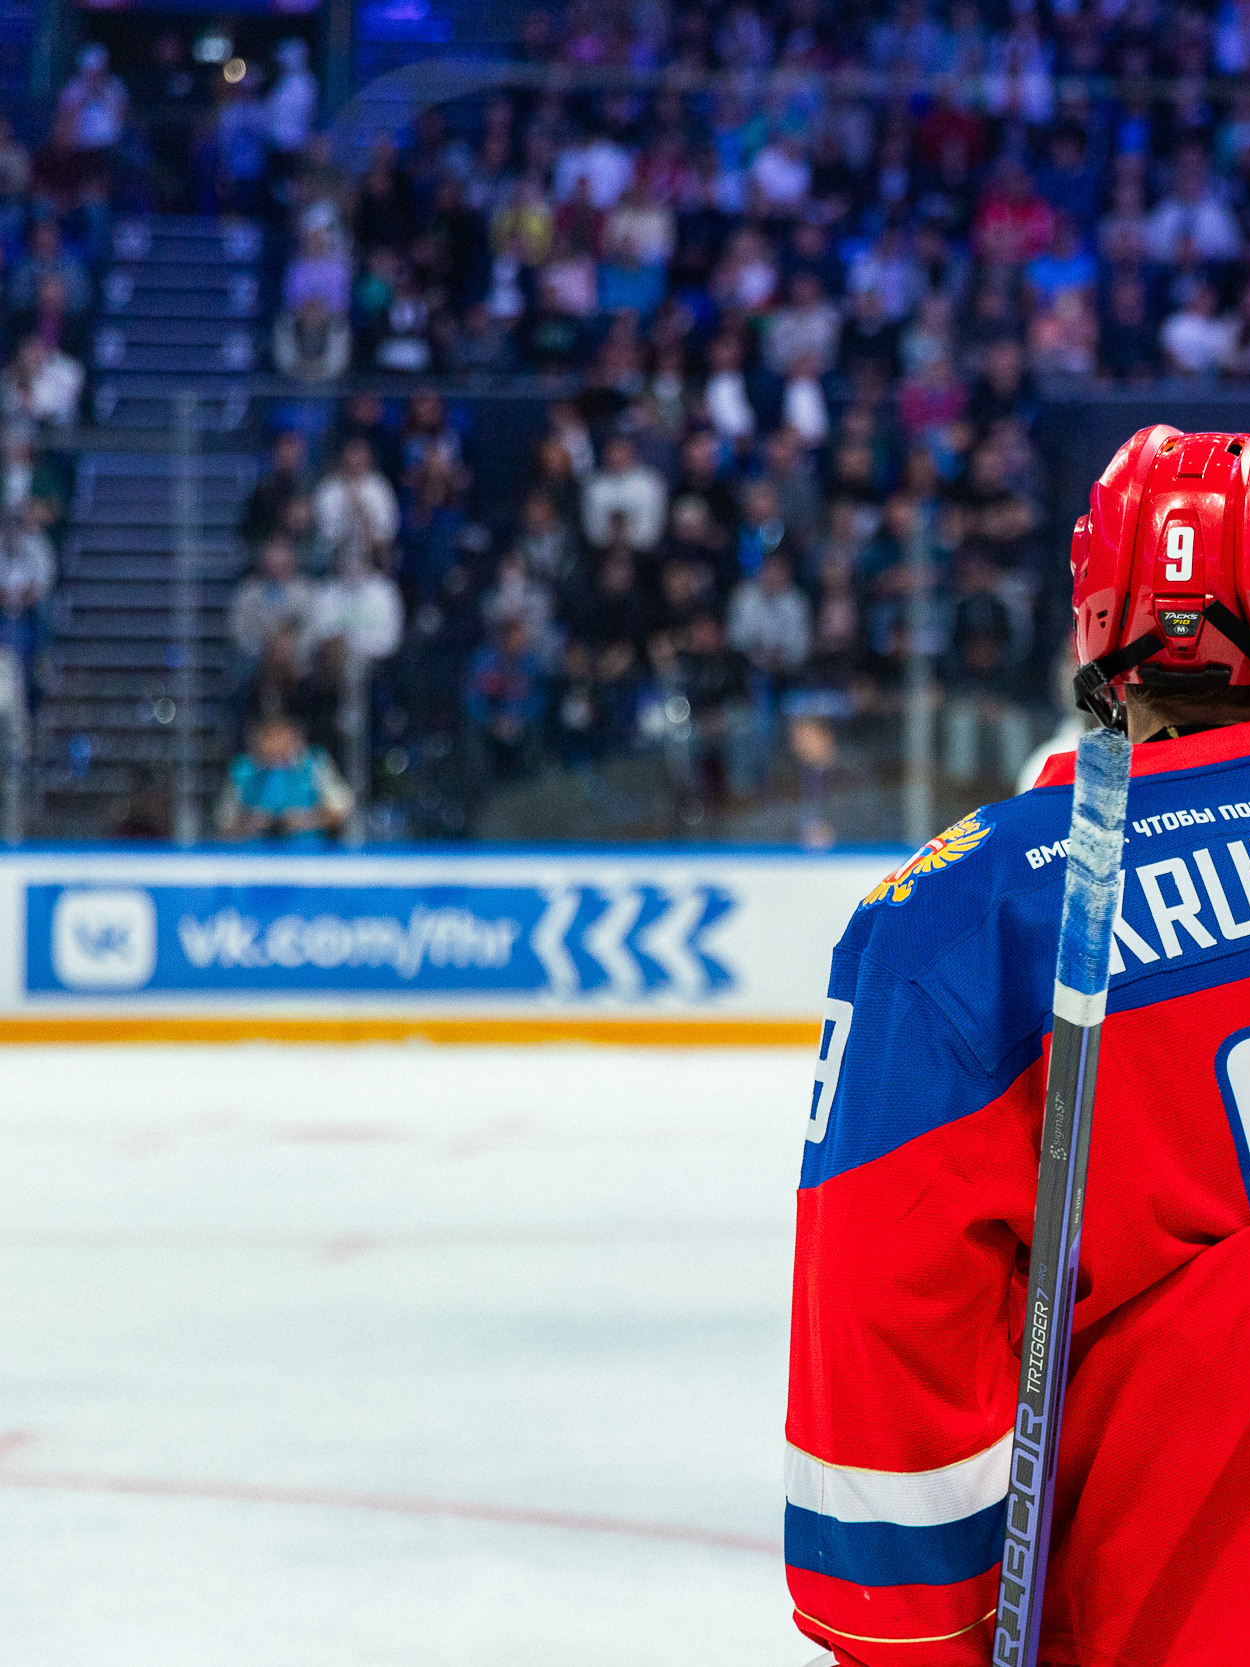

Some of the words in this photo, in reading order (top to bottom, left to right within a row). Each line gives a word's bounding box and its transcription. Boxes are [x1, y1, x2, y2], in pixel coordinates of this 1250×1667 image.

[1165, 526, 1195, 582] 9
[1165, 612, 1199, 620] TACKS
[1132, 807, 1217, 837] ЧТОБЫ
[1036, 1288, 1050, 1301] 7
[1026, 1301, 1049, 1394] TRIGGER
[992, 1402, 1046, 1667] RIBCOR
